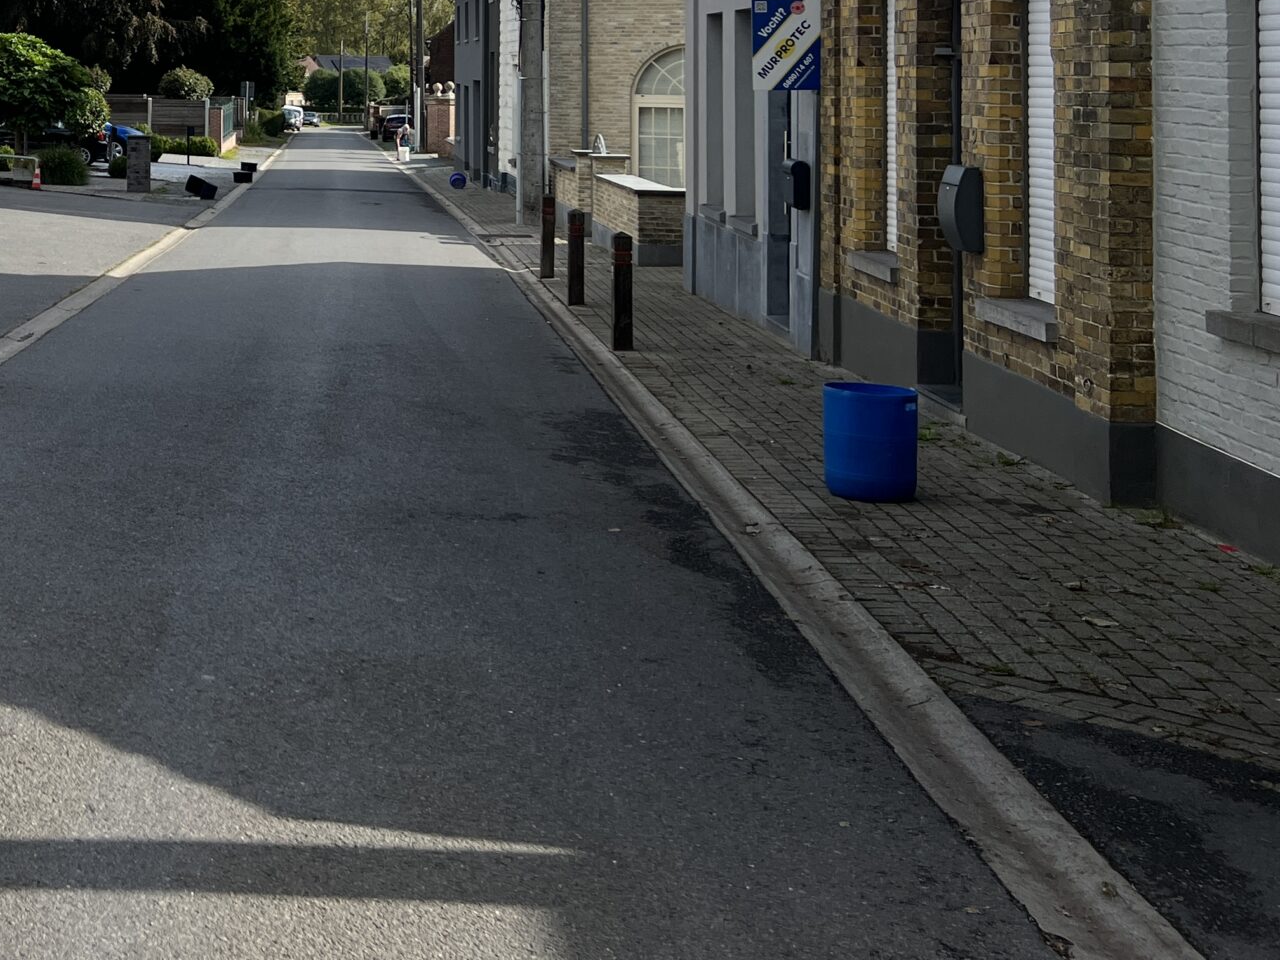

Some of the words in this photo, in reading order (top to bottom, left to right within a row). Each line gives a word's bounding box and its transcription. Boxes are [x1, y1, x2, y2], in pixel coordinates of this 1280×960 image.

[757, 7, 787, 38] Vocht?
[757, 20, 811, 80] MURPROTEC
[782, 64, 806, 89] 0800/14
